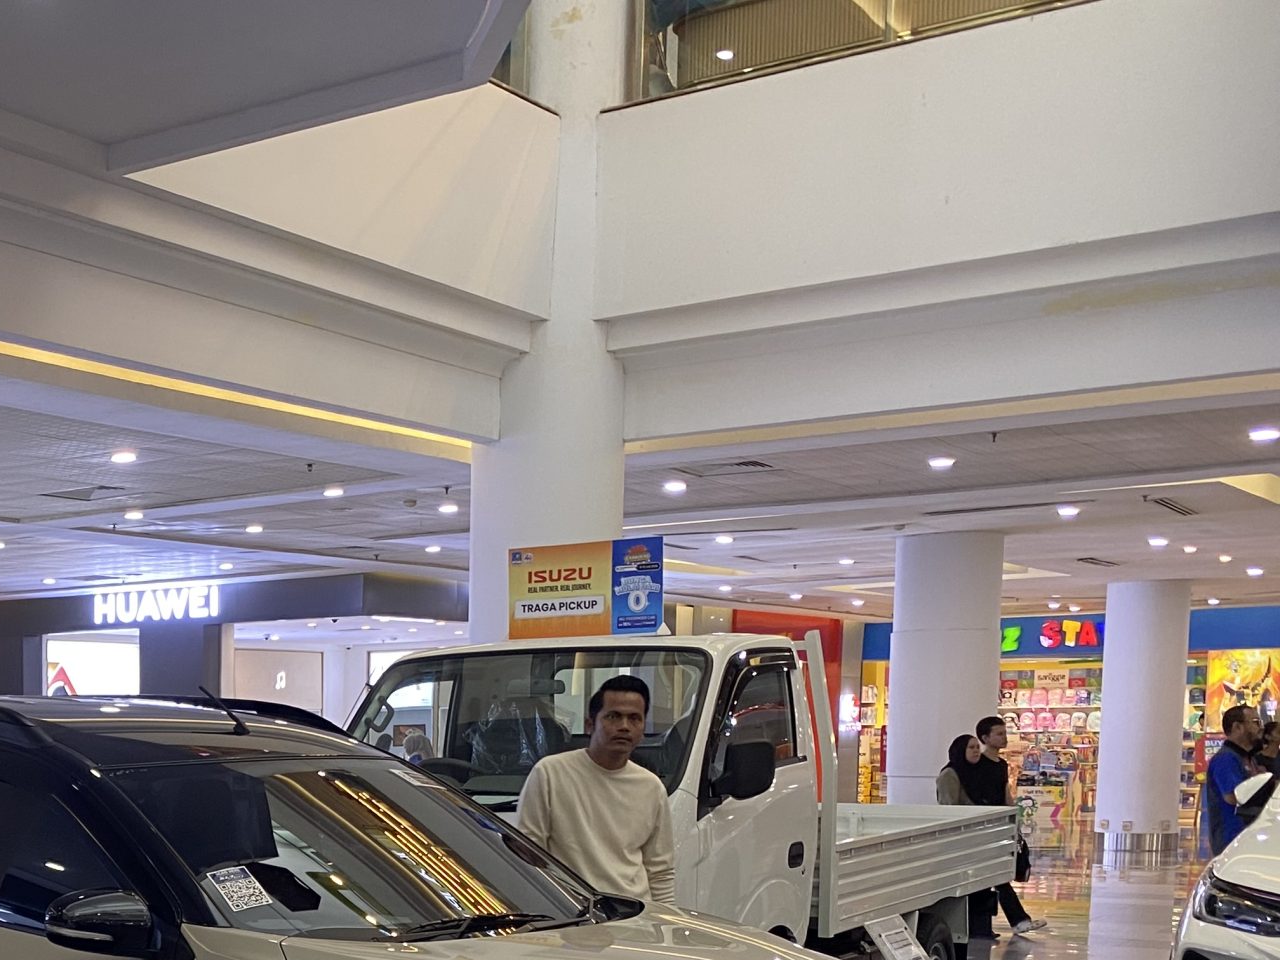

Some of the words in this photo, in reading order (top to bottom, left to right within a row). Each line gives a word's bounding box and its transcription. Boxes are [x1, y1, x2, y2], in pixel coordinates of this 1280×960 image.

[528, 566, 592, 584] ISUZU
[93, 585, 220, 625] HUAWEI
[521, 602, 557, 613] TRAGA
[558, 600, 598, 611] PICKUP
